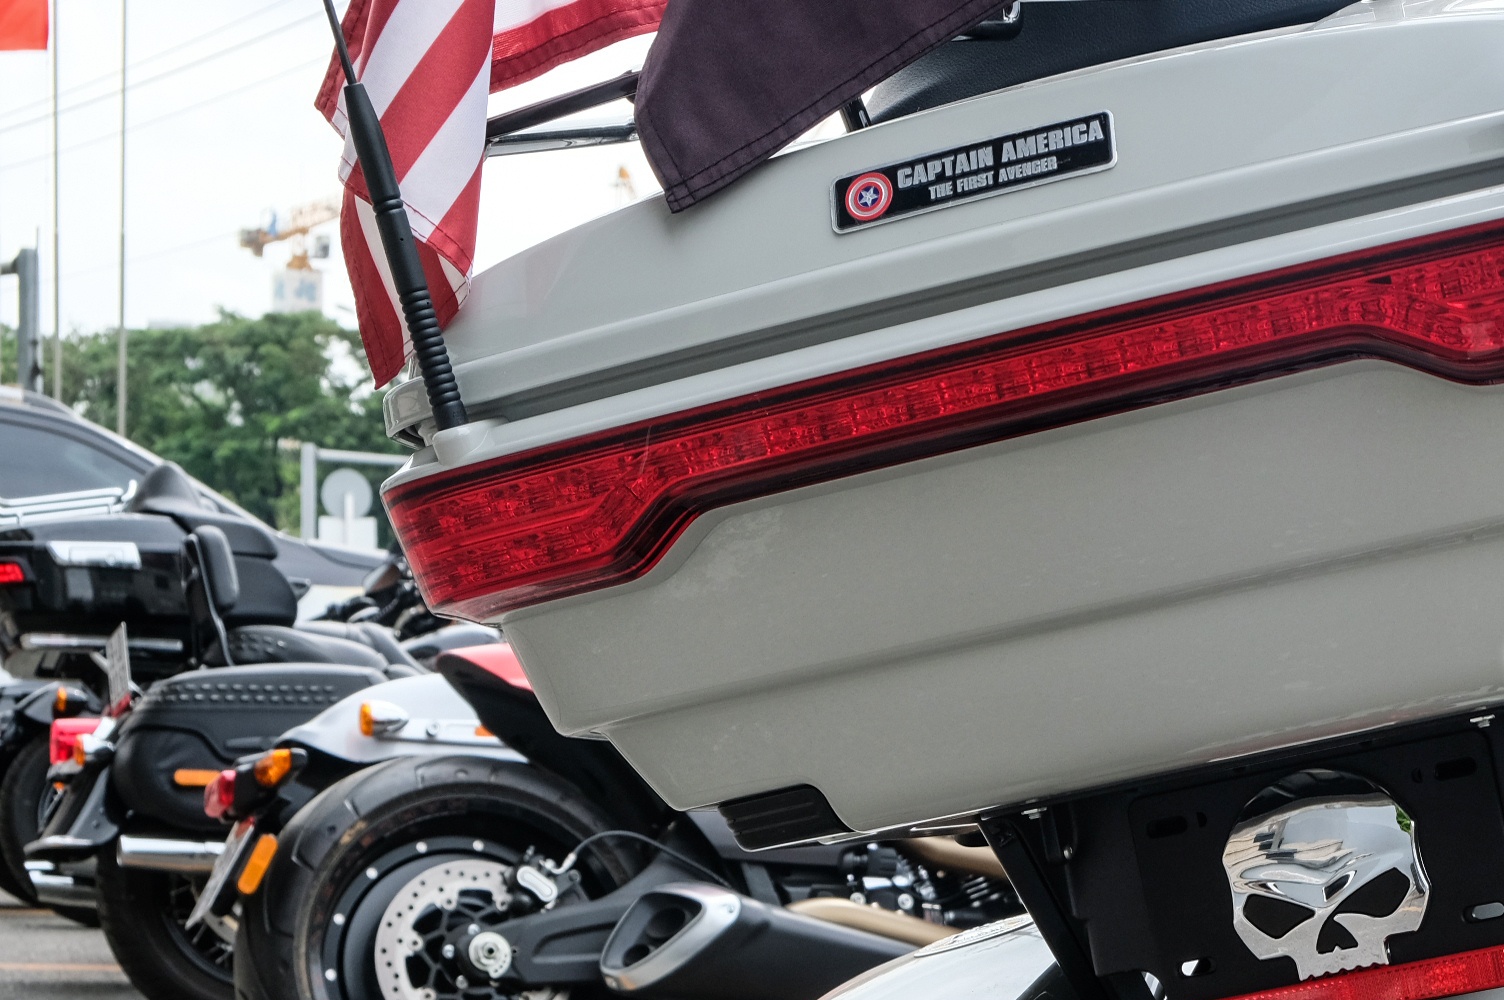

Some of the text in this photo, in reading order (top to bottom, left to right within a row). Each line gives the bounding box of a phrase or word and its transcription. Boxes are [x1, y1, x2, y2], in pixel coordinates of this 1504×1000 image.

[897, 119, 1105, 189] CAPTAIN AMERICA
[928, 155, 1058, 200] THE FIRST AVENGER
